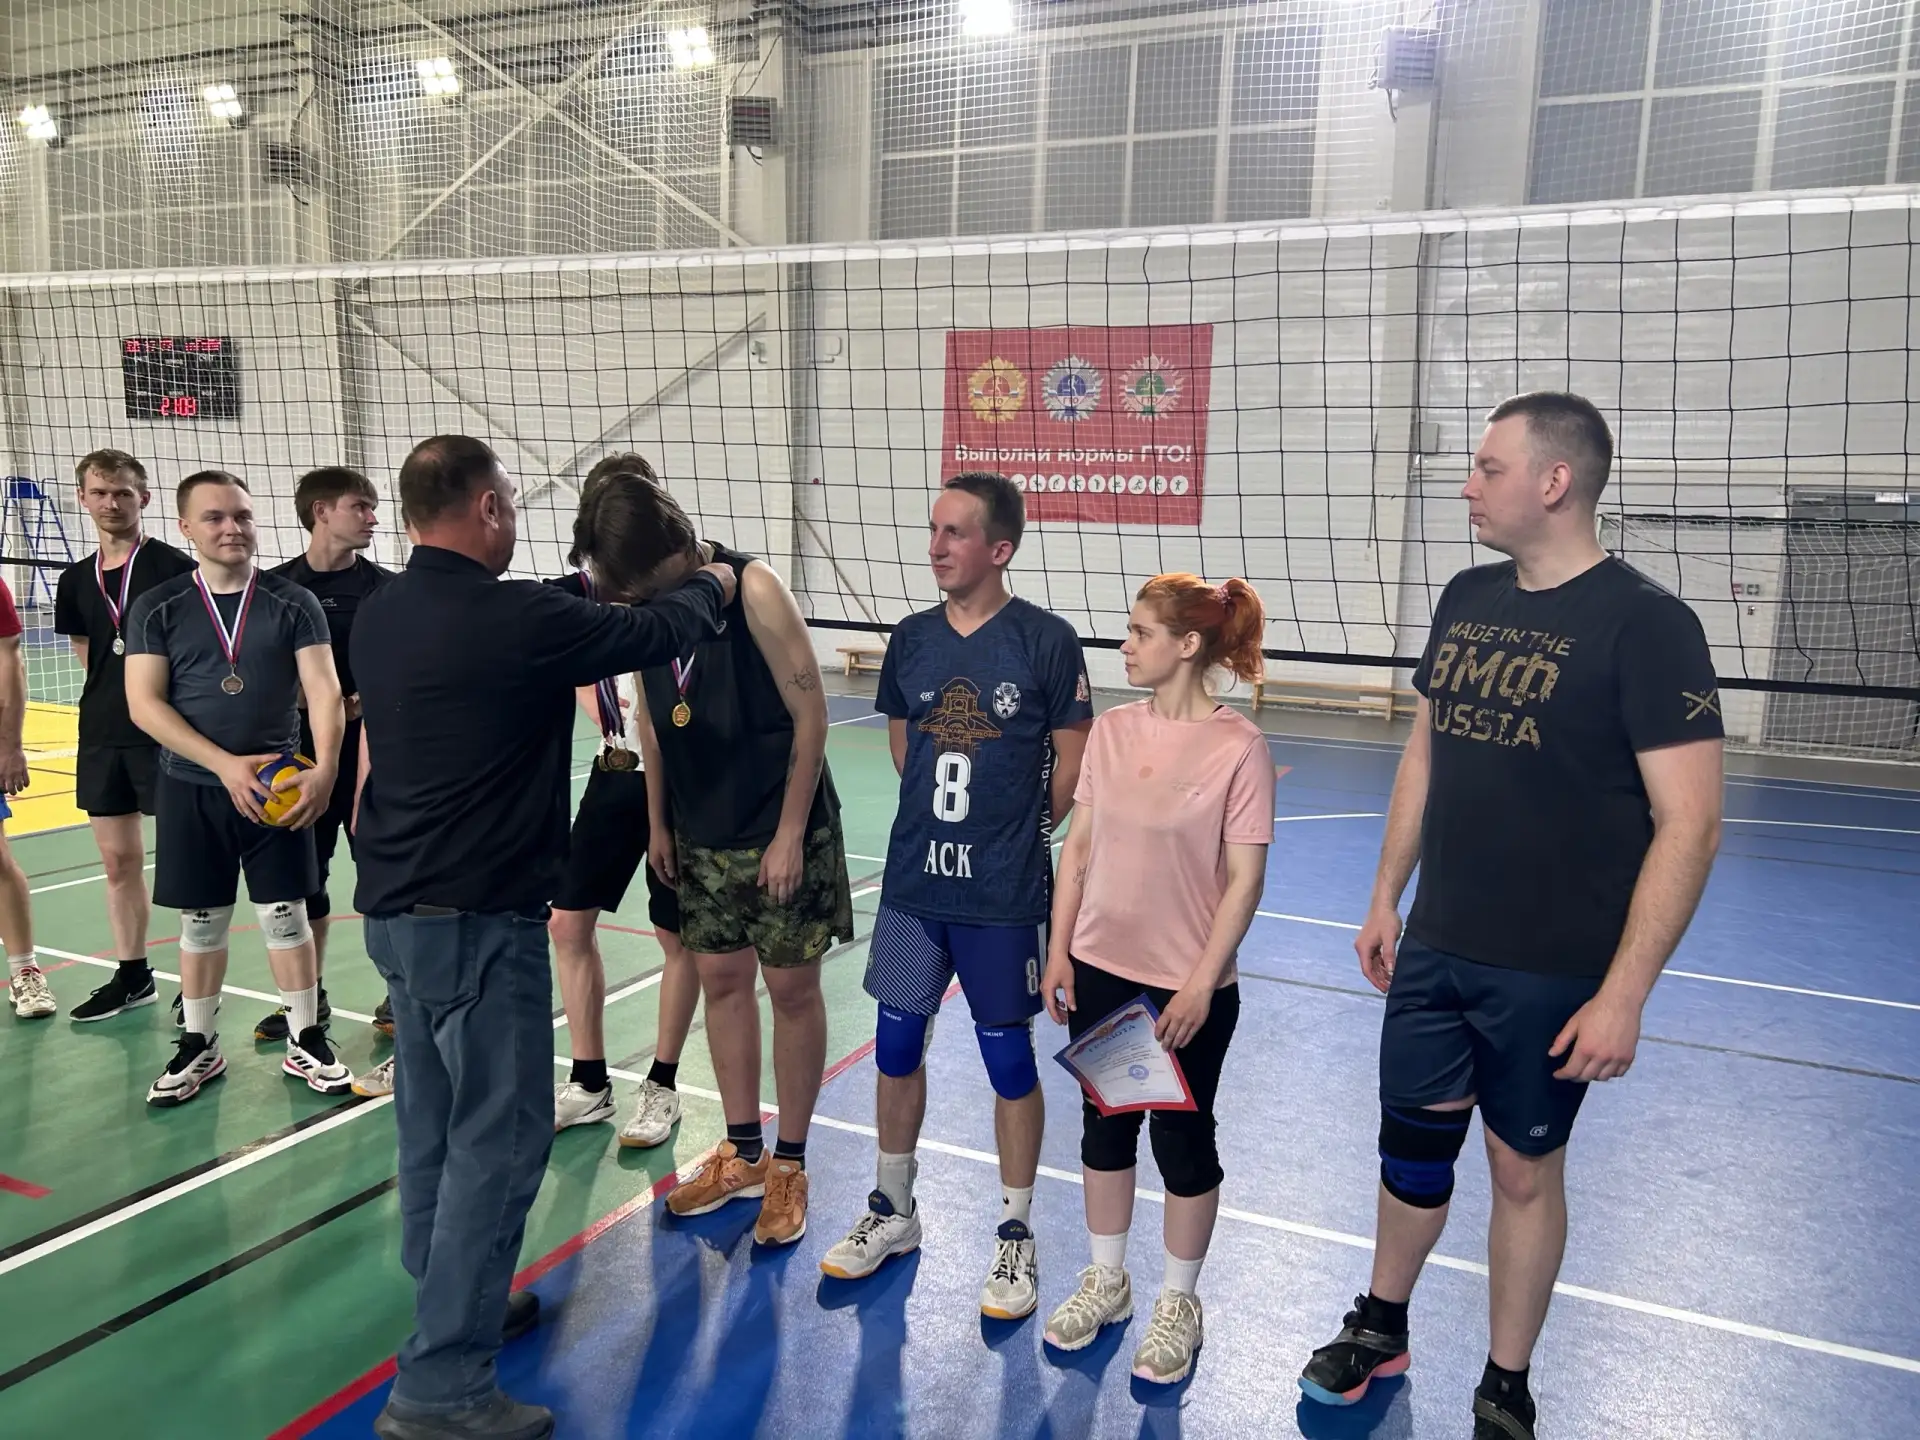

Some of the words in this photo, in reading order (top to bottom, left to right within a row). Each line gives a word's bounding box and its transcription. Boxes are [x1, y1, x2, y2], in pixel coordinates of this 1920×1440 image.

[954, 444, 1051, 463] Выполни
[1057, 447, 1134, 466] нормы
[1140, 444, 1193, 463] ГТО!
[1446, 620, 1499, 642] MADE
[1527, 630, 1577, 656] THE
[1429, 642, 1561, 707] ВМФ
[932, 750, 973, 823] 8
[923, 839, 974, 879] АСК
[1025, 957, 1039, 996] 8
[882, 1009, 902, 1021] VIKING
